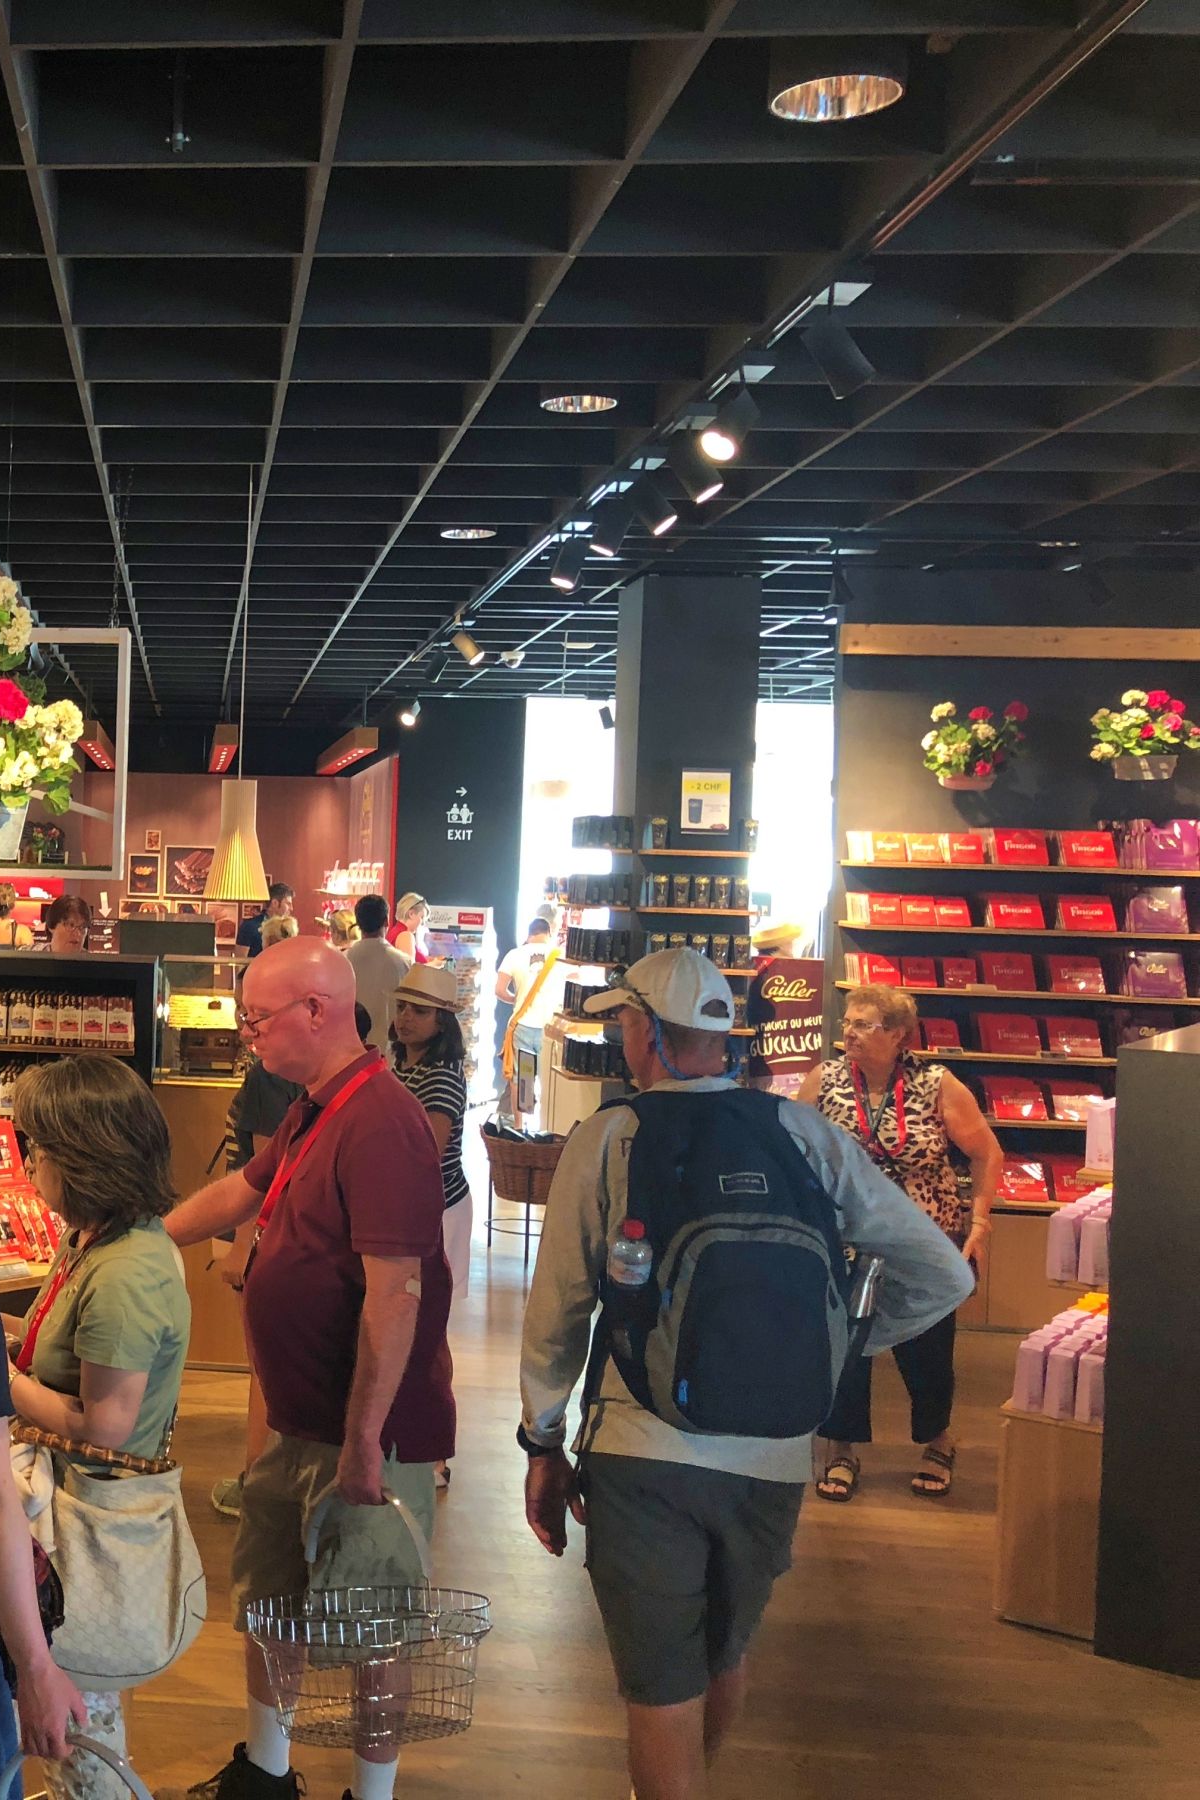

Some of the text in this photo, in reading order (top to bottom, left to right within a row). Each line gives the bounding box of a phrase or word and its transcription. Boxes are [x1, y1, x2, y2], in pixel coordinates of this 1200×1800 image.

[447, 829, 473, 841] EXIT
[761, 974, 818, 1002] Cailler
[804, 1015, 823, 1027] HEUT
